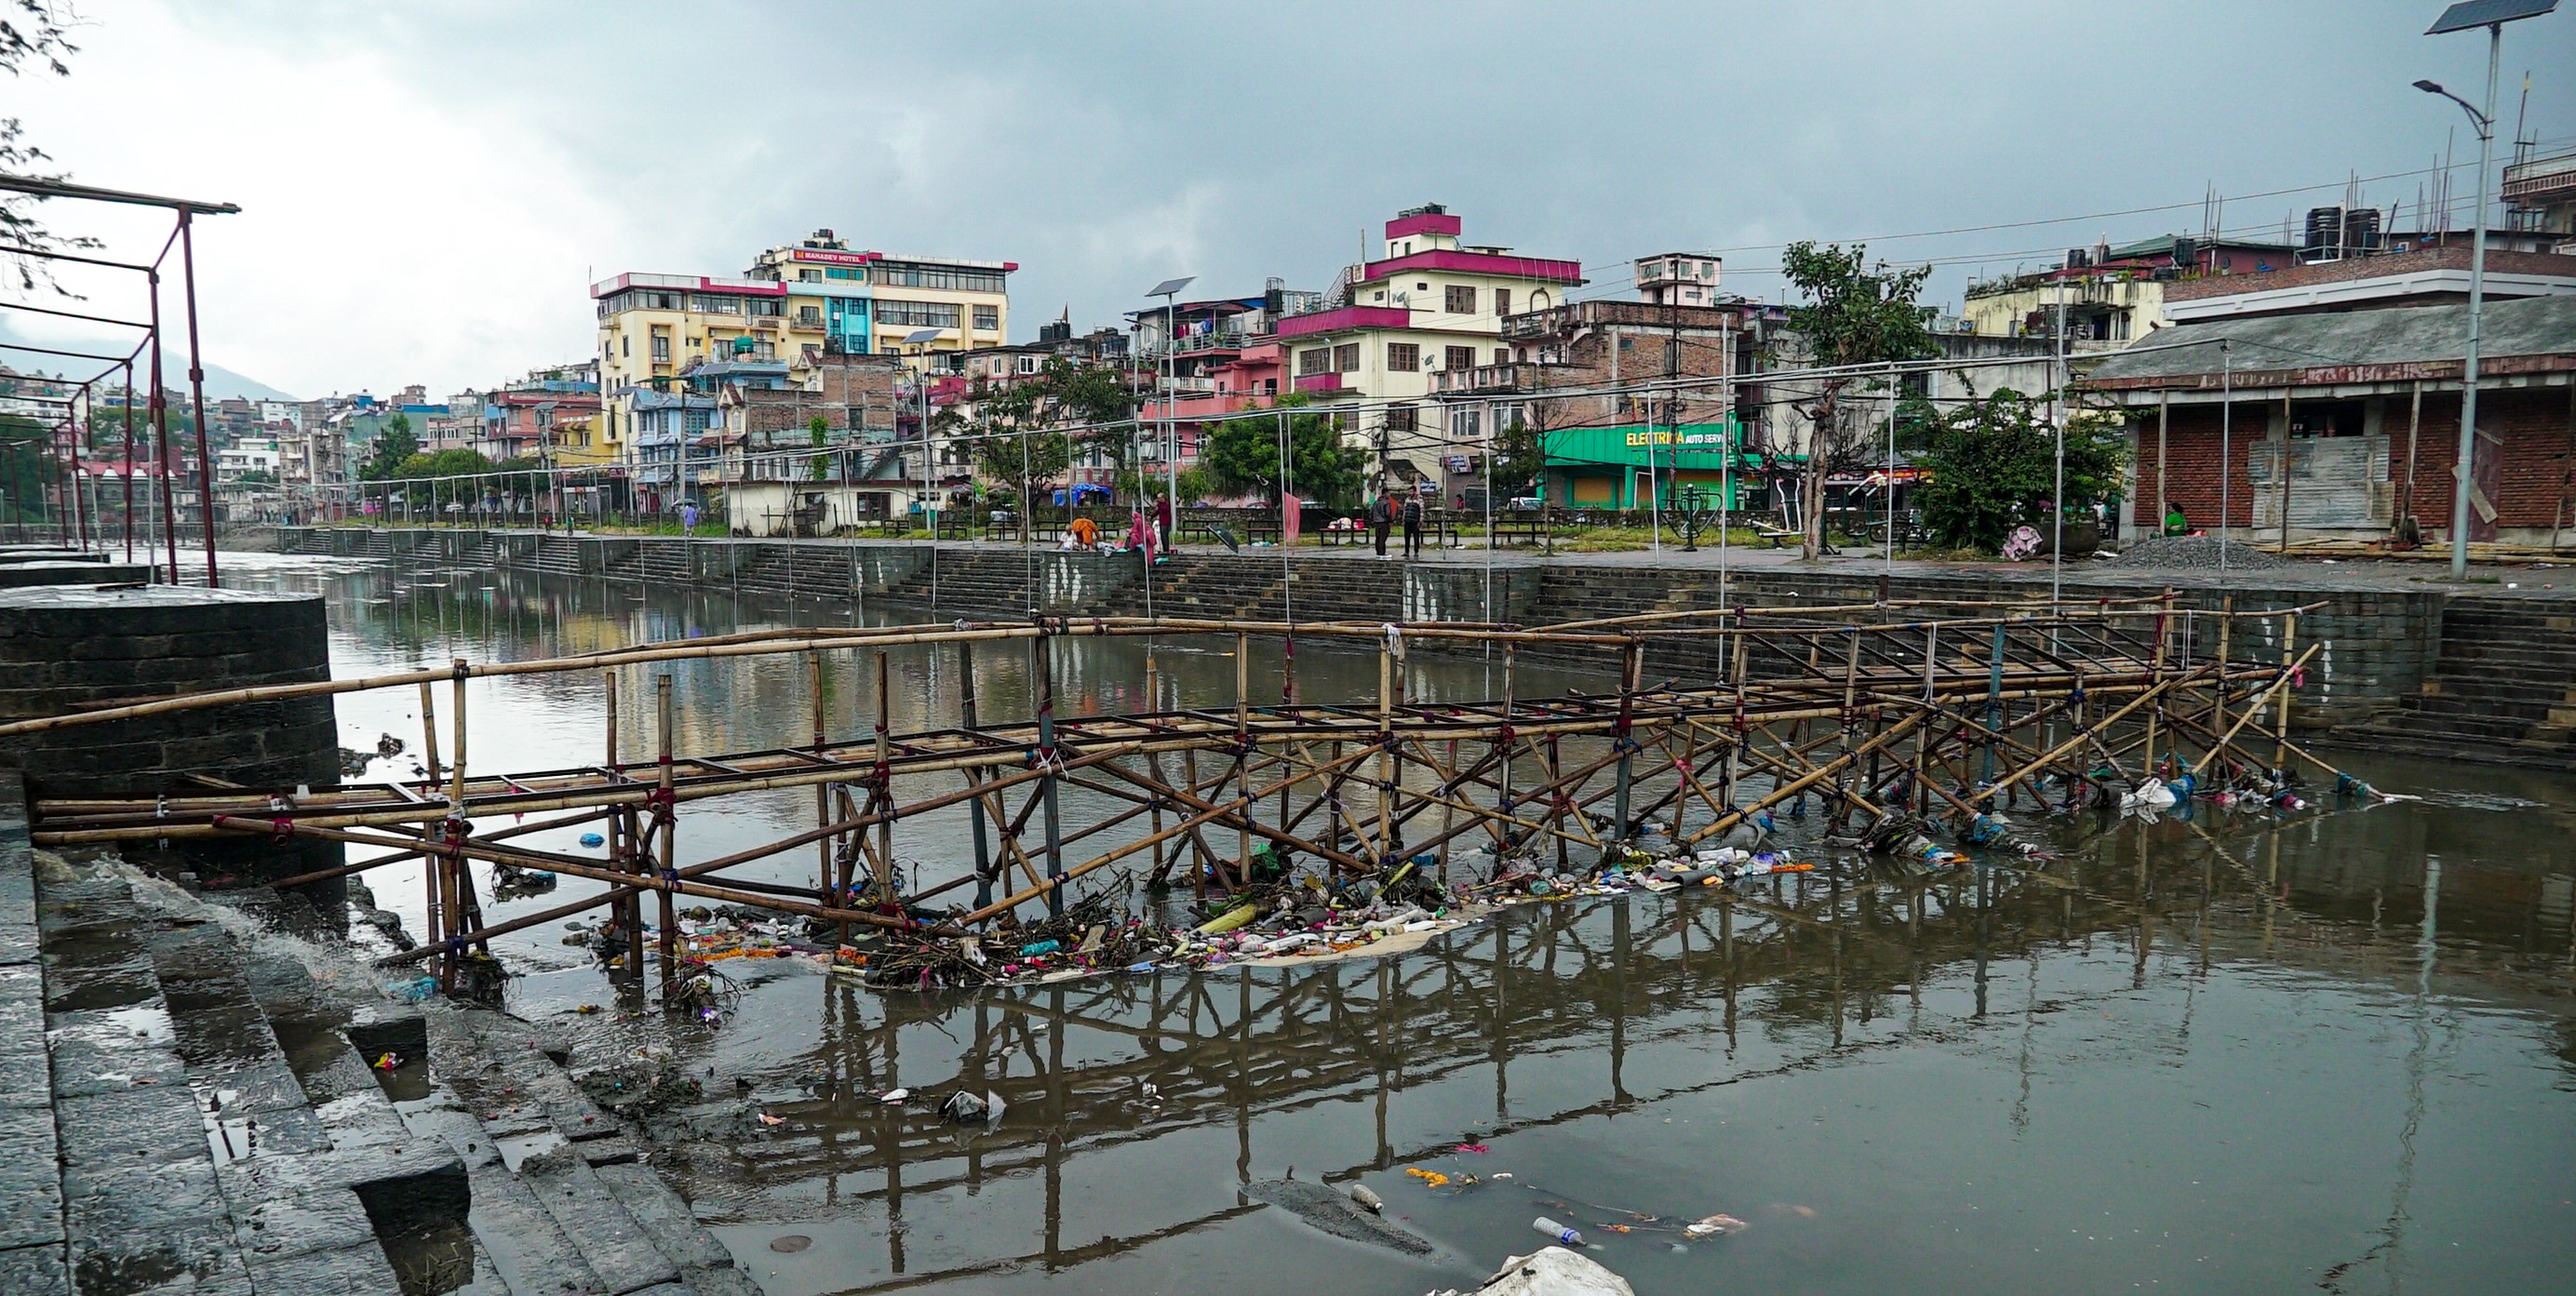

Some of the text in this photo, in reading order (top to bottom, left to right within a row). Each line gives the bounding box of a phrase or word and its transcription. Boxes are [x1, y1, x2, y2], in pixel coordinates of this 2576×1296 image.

[1626, 431, 1724, 446] ELECTRIA AUTO SERV
